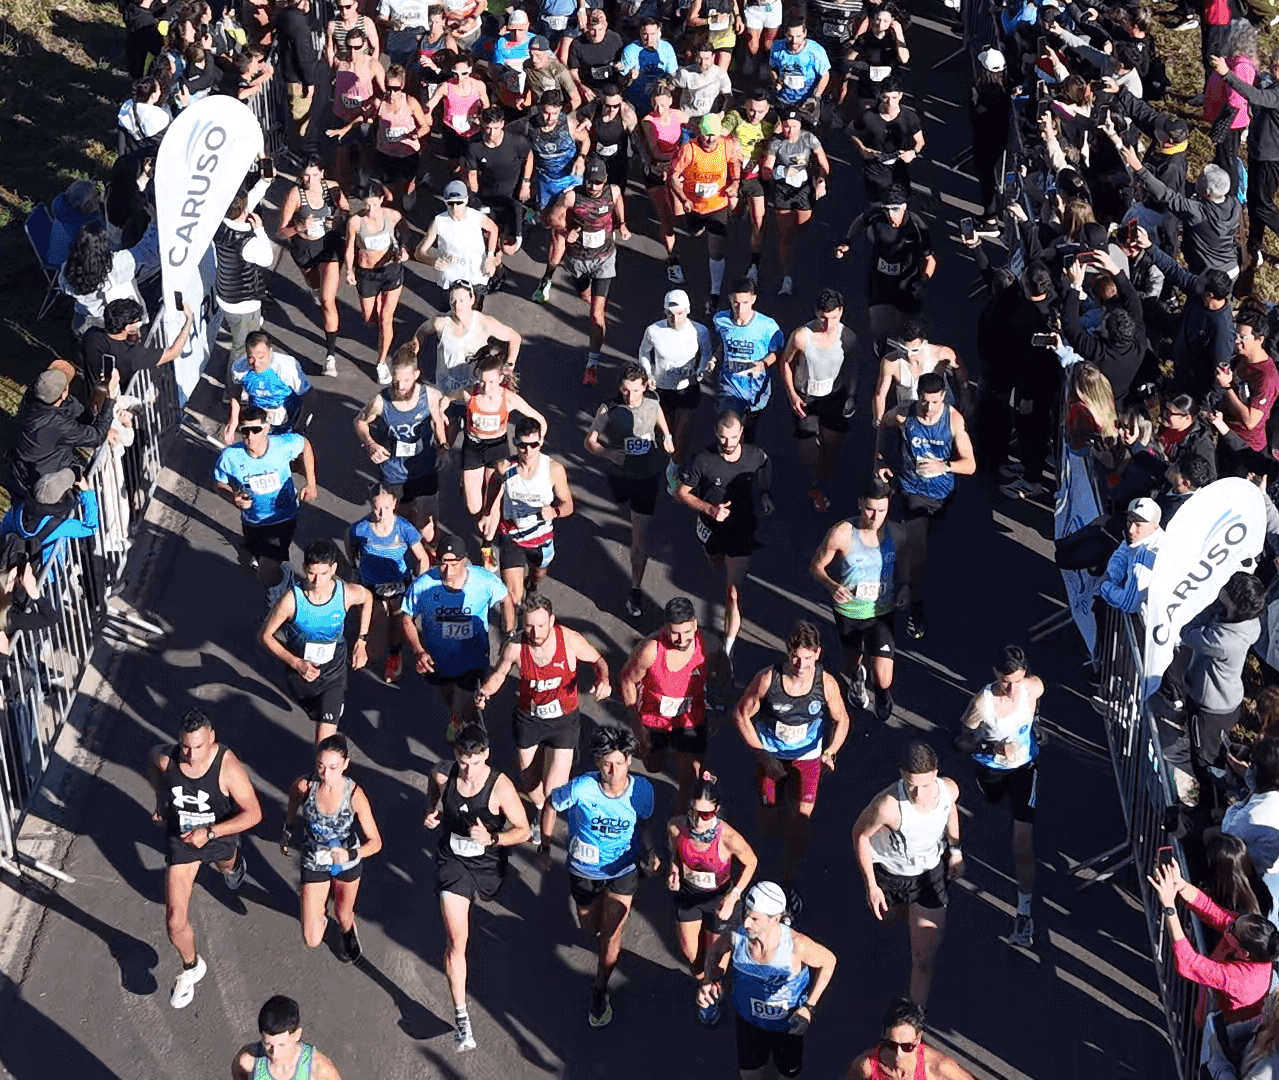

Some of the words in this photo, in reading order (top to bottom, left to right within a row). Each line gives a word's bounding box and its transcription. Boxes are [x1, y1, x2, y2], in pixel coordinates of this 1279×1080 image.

[168, 125, 227, 268] CARUSO
[626, 439, 650, 451] 694
[1152, 522, 1248, 646] CARUSO
